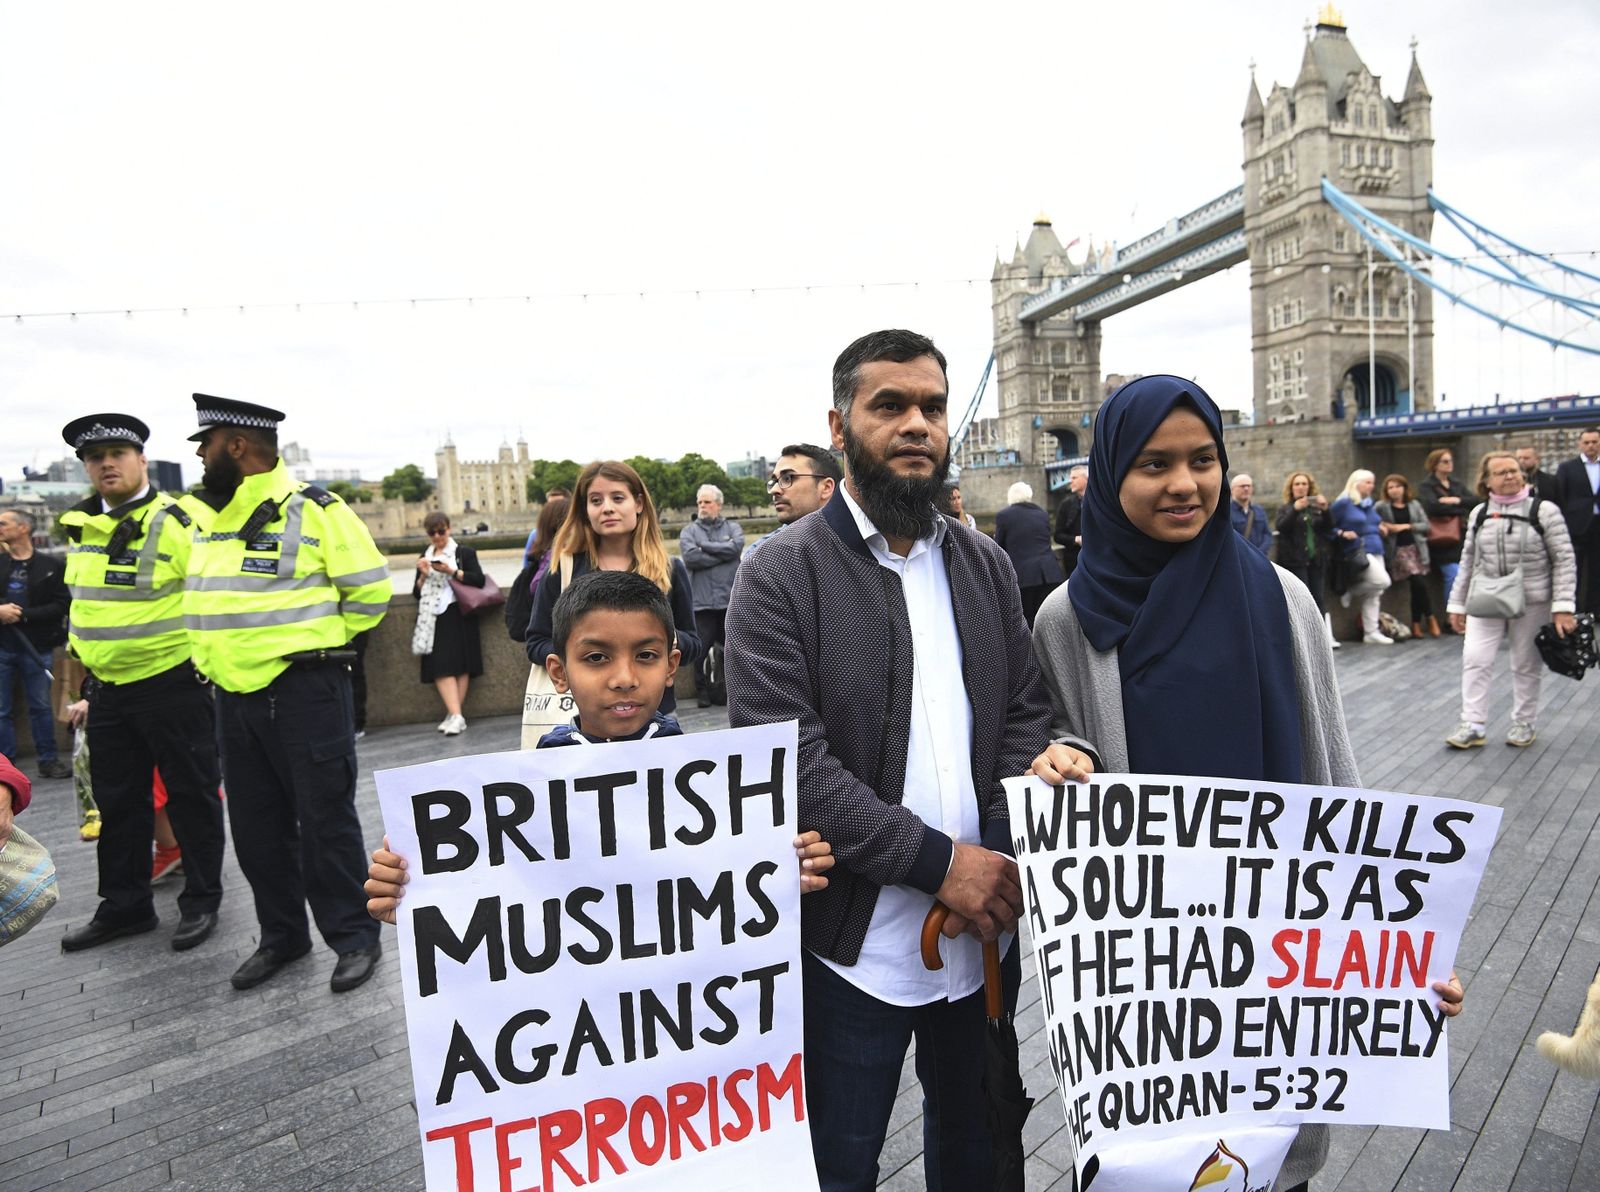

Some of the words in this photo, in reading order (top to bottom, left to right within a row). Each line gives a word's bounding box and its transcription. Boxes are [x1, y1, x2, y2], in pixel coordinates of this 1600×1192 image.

[411, 747, 786, 875] BRITISH
[1014, 783, 1286, 857] ...WHOEVER
[1303, 797, 1475, 864] KILLS
[412, 860, 780, 998] MUSLIMS
[1026, 865, 1047, 938] A
[1285, 858, 1335, 920] IS
[1340, 864, 1431, 923] AS
[1038, 939, 1063, 1020] IF
[1072, 929, 1134, 1002] HE
[1144, 926, 1255, 991] HAD
[1267, 928, 1435, 990] SLAIN
[1233, 996, 1446, 1058] ENTIRELY
[436, 960, 790, 1106] AGAINST
[426, 1053, 806, 1192] TERRORISM
